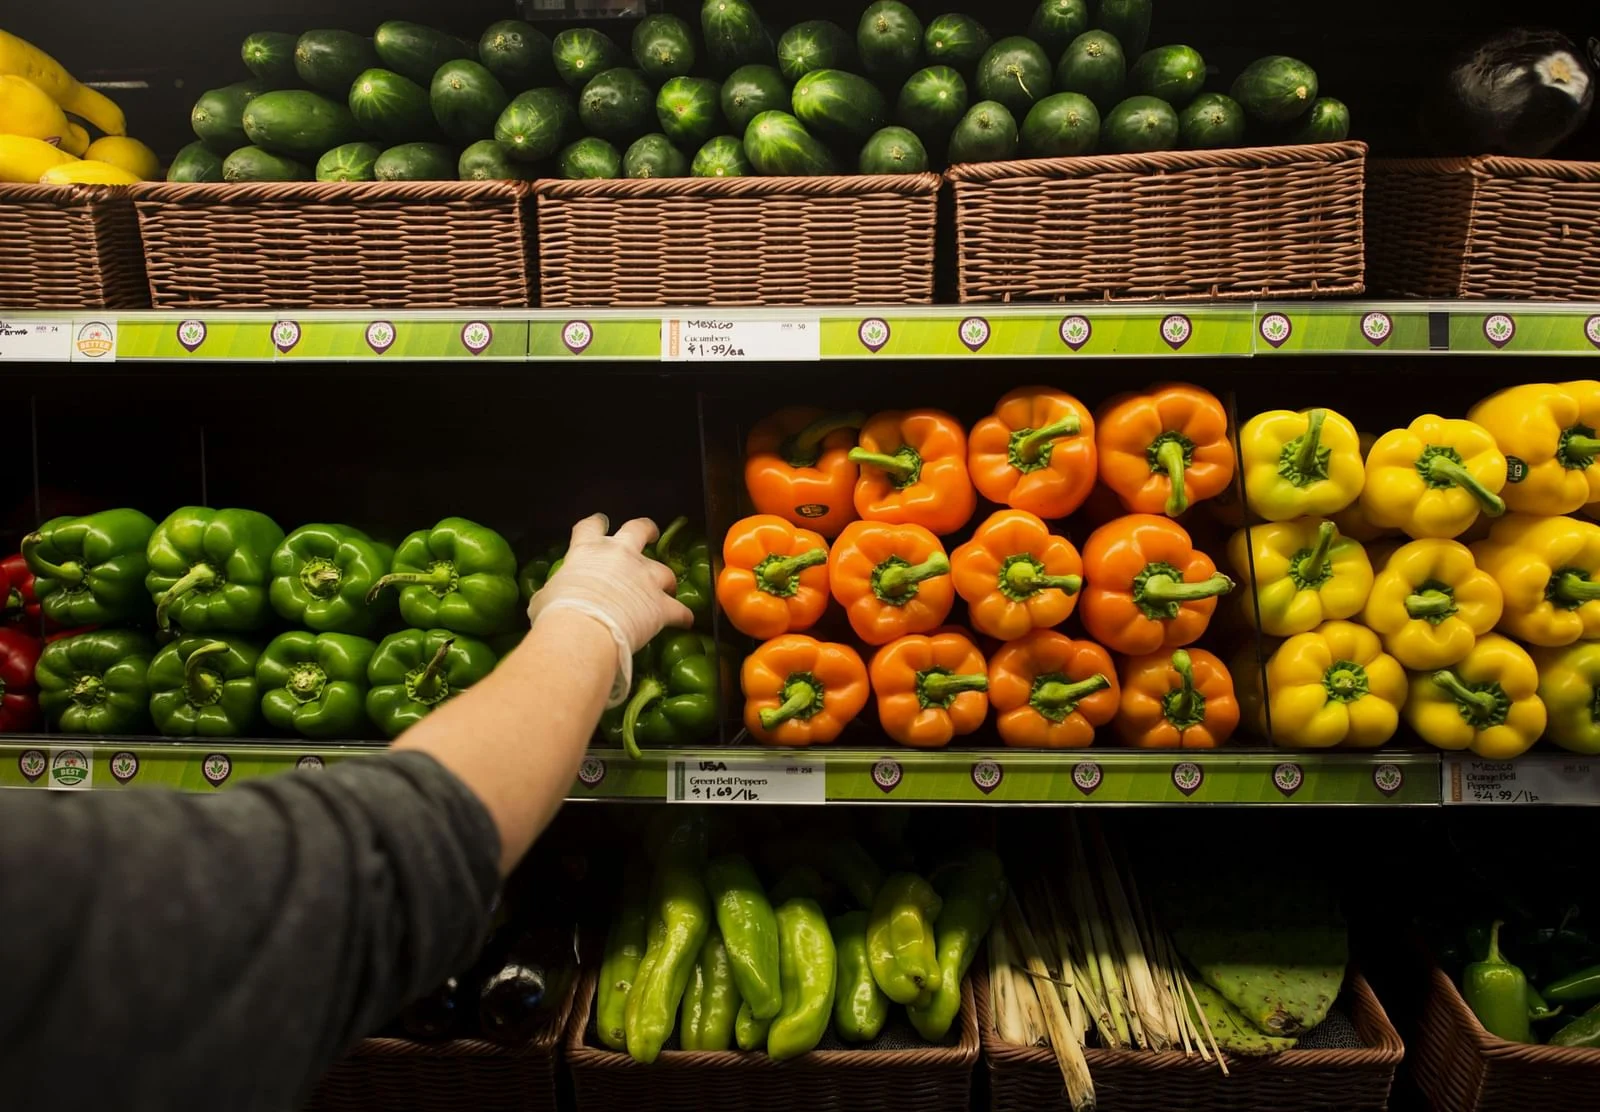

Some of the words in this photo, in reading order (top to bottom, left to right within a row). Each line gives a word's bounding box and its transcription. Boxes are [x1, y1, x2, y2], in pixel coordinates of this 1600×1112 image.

[688, 320, 734, 329] Mexico
[80, 342, 110, 350] BETTER
[699, 761, 727, 771] USA
[1472, 762, 1514, 771] Mexico
[690, 776, 715, 785] Green
[717, 777, 733, 785] Bell
[734, 777, 768, 786] Peppers
[1466, 773, 1498, 782] Orange
[1467, 782, 1502, 790] Peppers
